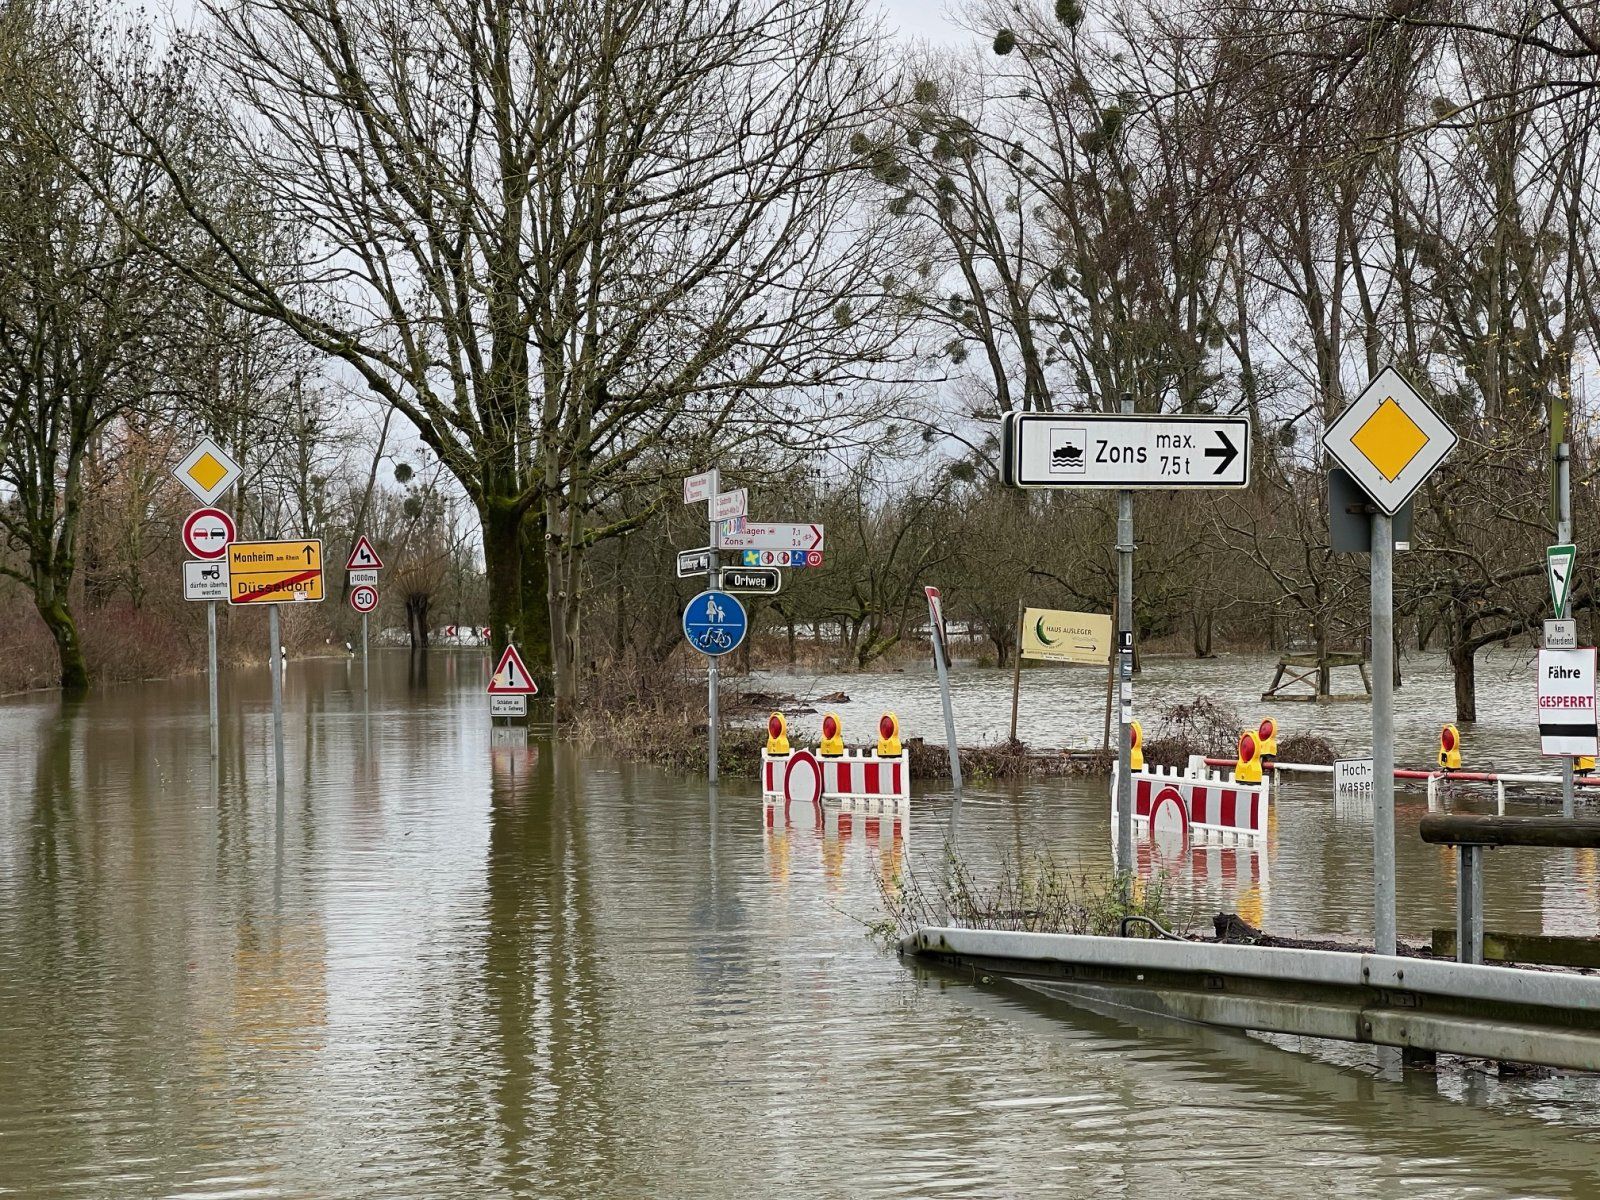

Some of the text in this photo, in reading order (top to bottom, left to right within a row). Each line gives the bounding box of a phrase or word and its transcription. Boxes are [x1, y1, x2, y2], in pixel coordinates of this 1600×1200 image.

[1156, 434, 1196, 449] max.
[1095, 440, 1148, 464] Zons
[1160, 455, 1191, 476] 7,5 t
[724, 537, 744, 546] Zons
[233, 551, 274, 563] Monheim
[189, 581, 208, 589] dürfen
[238, 579, 315, 595] Düsseldorf
[734, 574, 767, 588] Ortweg
[357, 592, 373, 605] 50
[1062, 627, 1092, 636] AUSLEGER
[1554, 624, 1565, 633] Kein
[1547, 633, 1574, 646] Winterdienst
[1548, 665, 1581, 679] Fähre
[1539, 695, 1594, 708] GESPERRT
[1342, 762, 1372, 776] Hoch-
